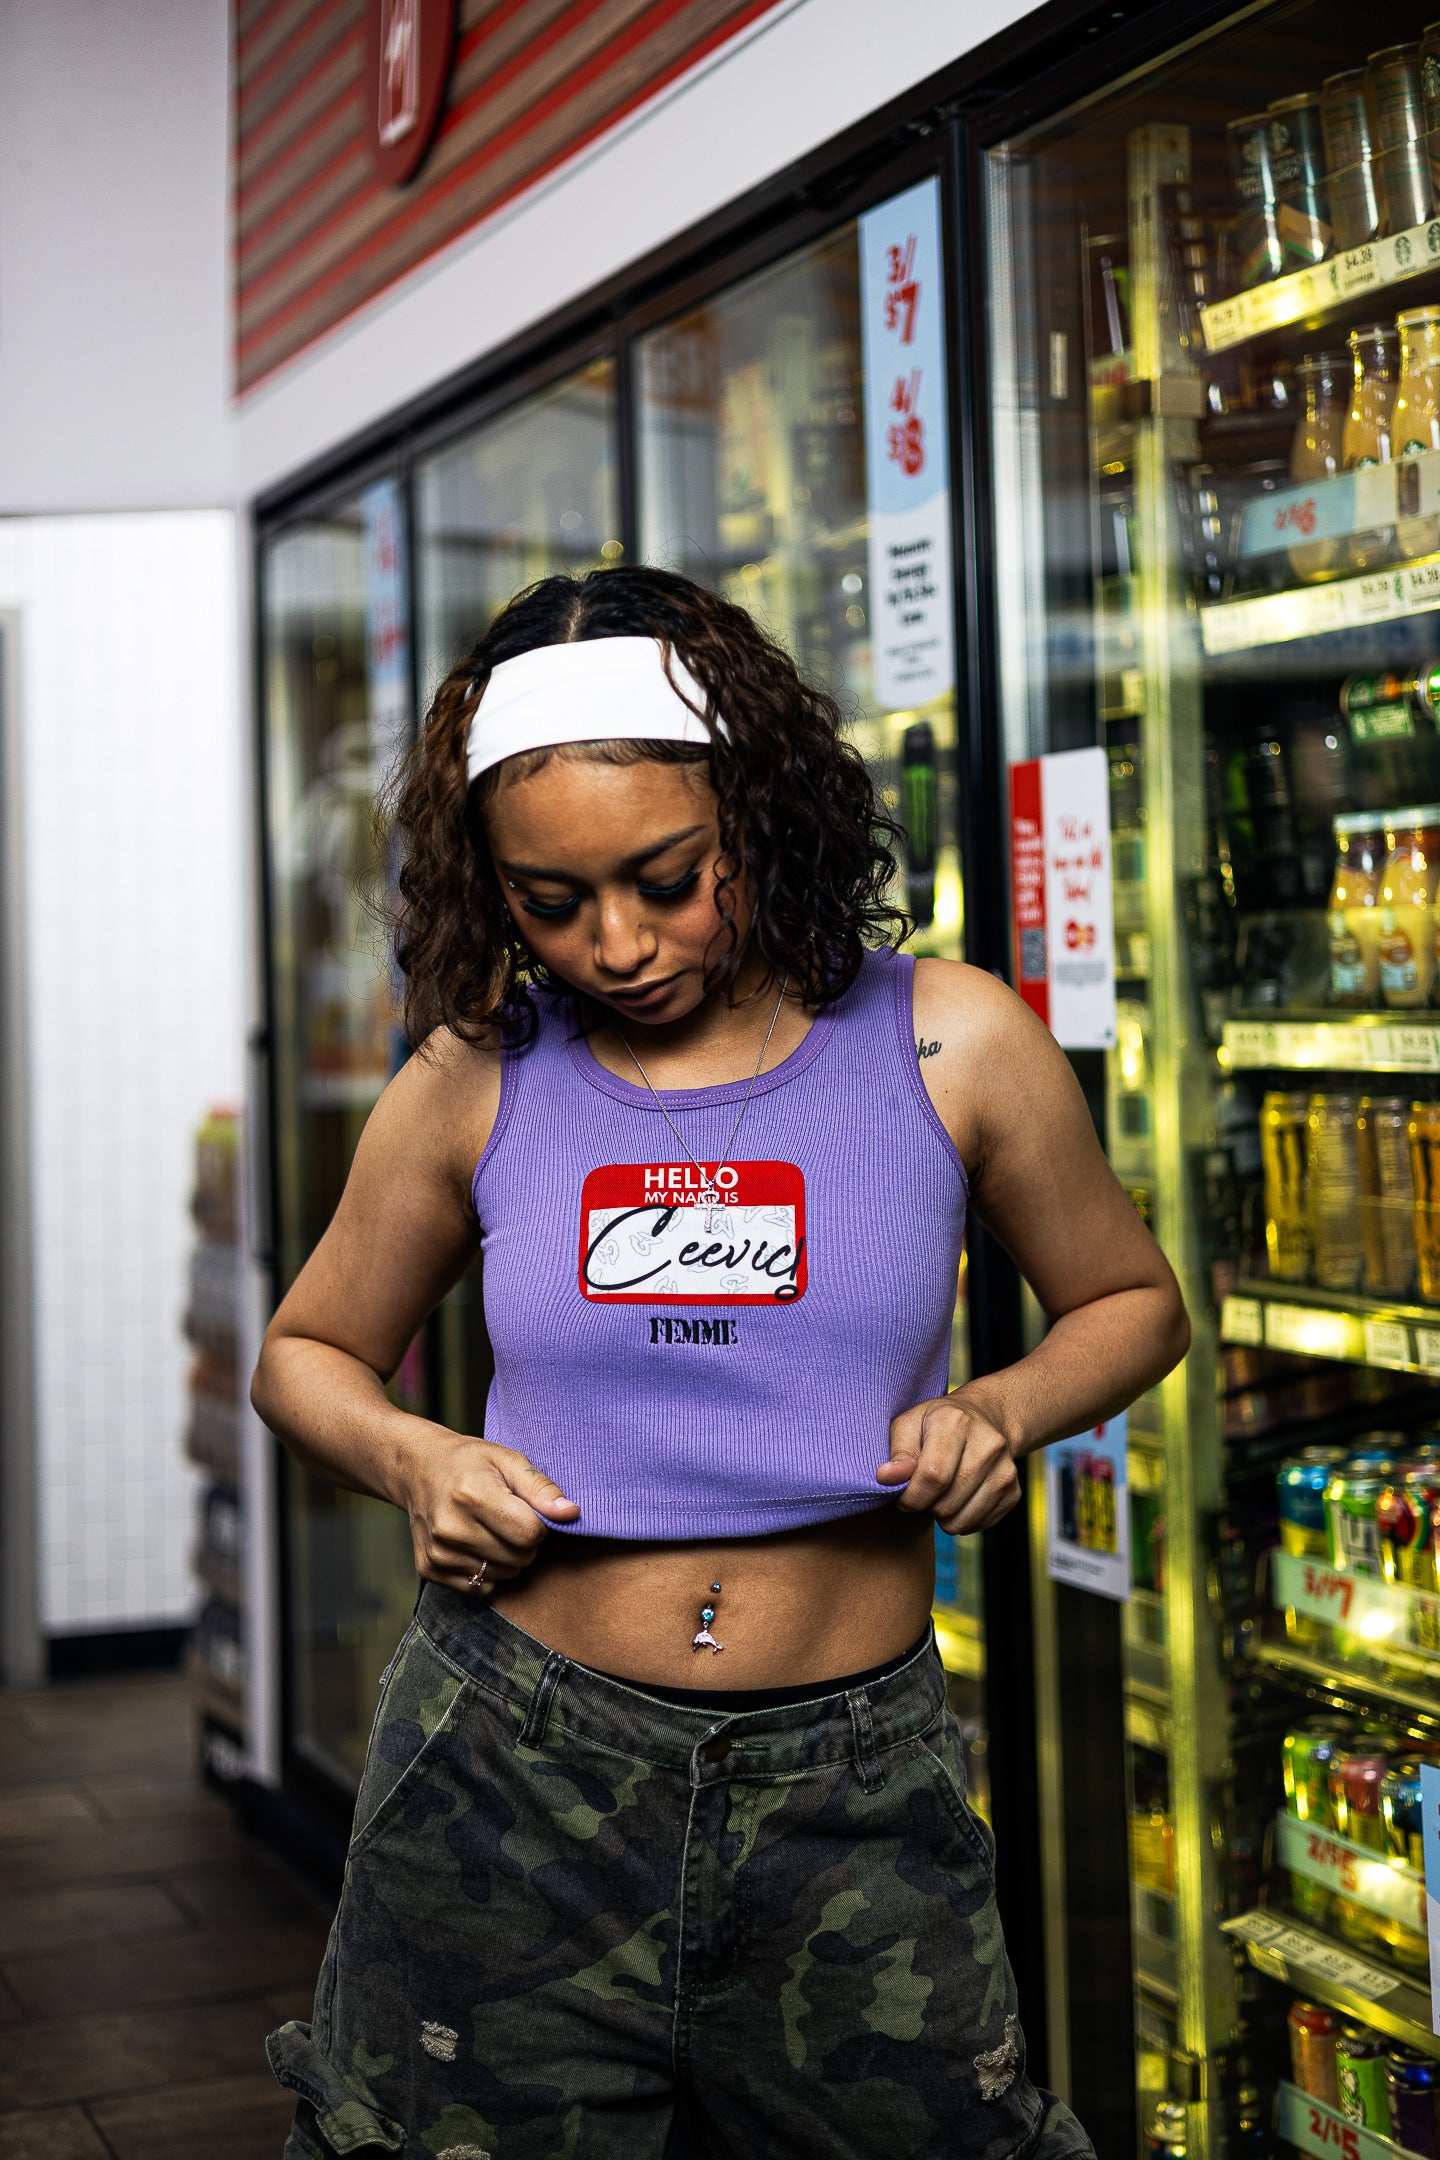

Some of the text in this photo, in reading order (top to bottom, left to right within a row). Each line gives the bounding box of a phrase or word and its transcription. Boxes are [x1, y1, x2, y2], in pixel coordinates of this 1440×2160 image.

[644, 1166, 739, 1189] HELLO
[644, 1191, 668, 1204] MY
[724, 1191, 739, 1204] IS
[650, 1317, 737, 1345] FEMME
